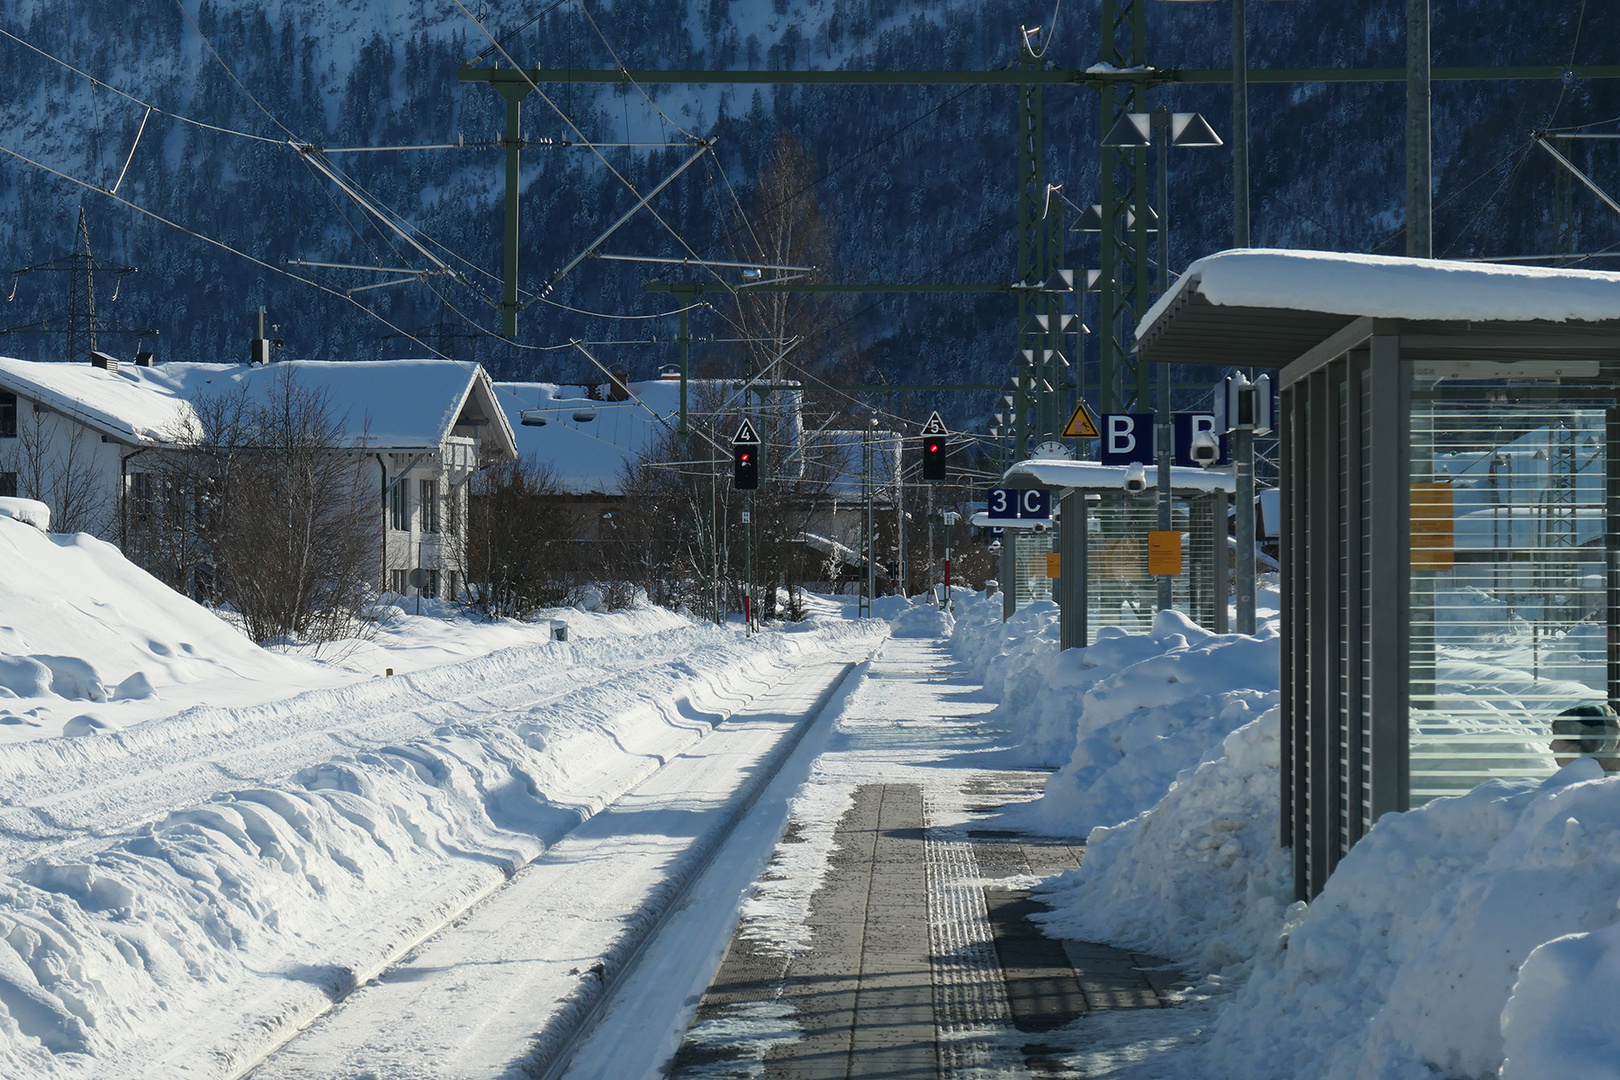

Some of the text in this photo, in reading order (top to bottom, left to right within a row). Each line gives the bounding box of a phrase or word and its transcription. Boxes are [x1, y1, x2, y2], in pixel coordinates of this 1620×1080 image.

[741, 427, 751, 440] 4
[930, 419, 939, 433] 5
[1108, 415, 1136, 454] B
[992, 490, 1041, 512] 3 C
